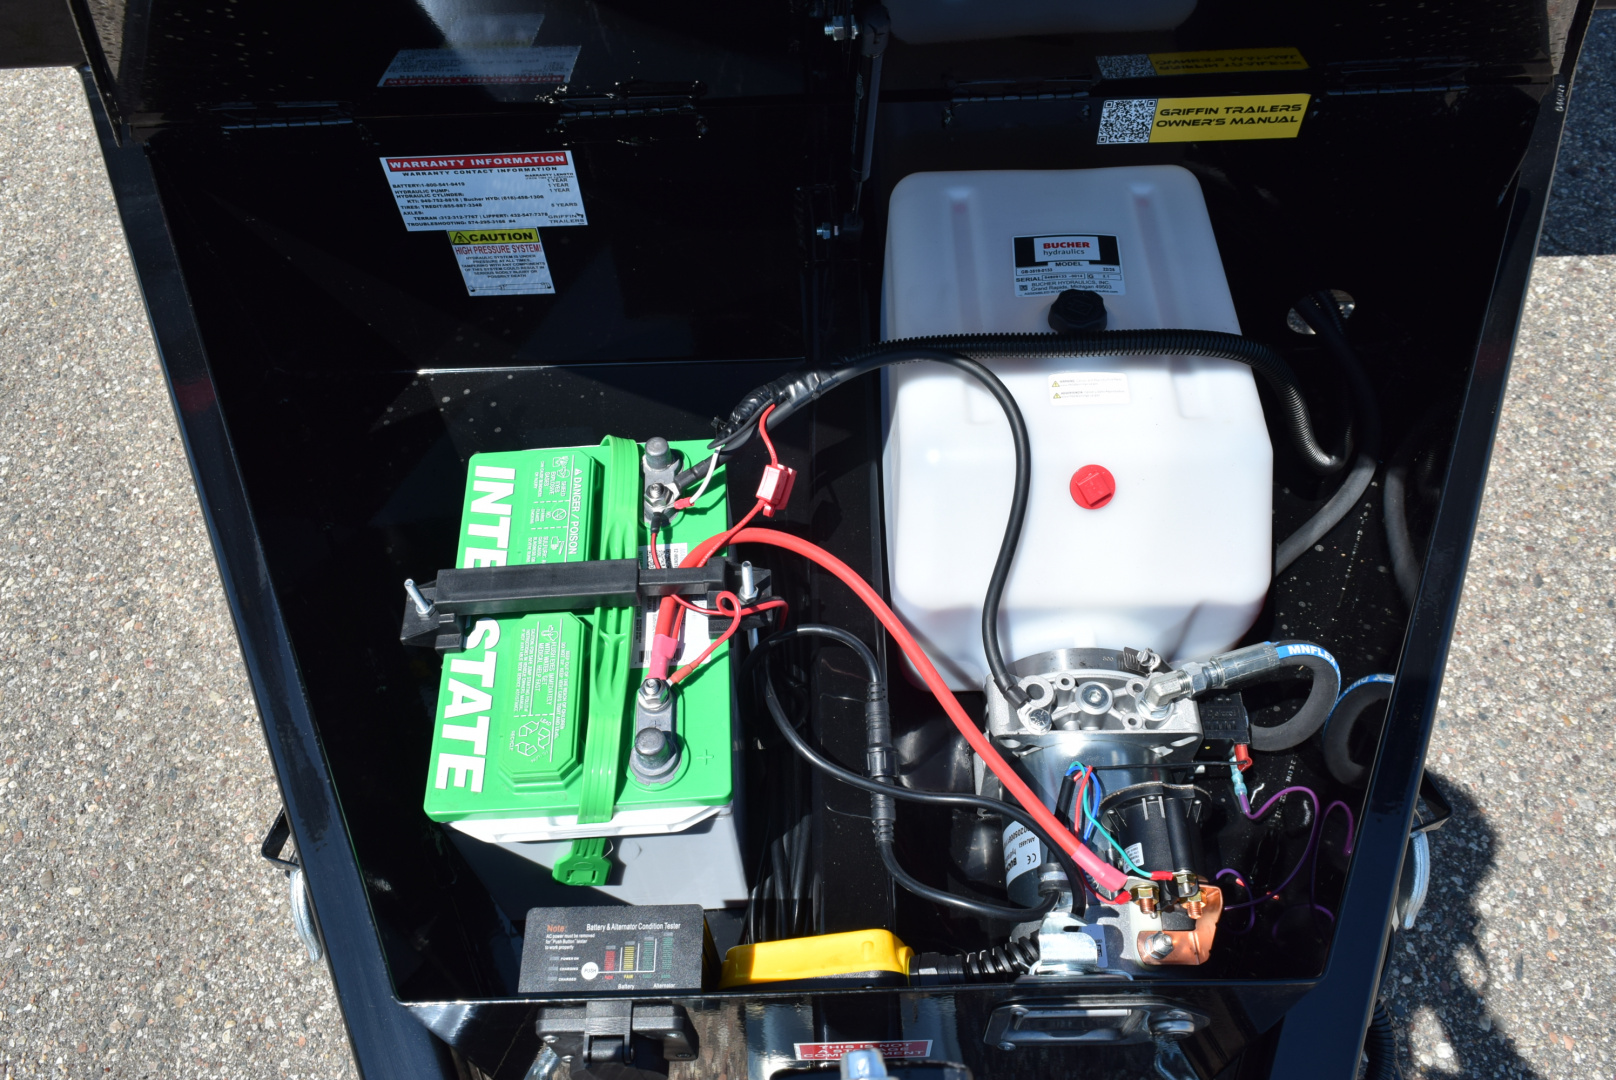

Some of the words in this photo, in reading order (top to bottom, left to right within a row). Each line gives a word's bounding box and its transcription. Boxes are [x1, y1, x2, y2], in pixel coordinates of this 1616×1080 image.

[1159, 106, 1219, 116] GRIFFIN
[1223, 104, 1303, 114] TRAILERS
[1156, 118, 1226, 127] OWNER'S
[1229, 115, 1299, 125] MANUAL
[389, 159, 465, 169] WARRANTY
[470, 155, 565, 166] INFORMATION
[468, 232, 533, 242] CAUTION
[455, 246, 474, 255] HIGH
[473, 244, 511, 254] PRESSURE
[511, 243, 542, 254] SYSTEM!
[1043, 241, 1091, 249] BUCHER
[1043, 249, 1085, 257] hydraulics
[571, 477, 584, 512] DANGER
[568, 521, 581, 555] POISON
[537, 642, 545, 664] MEDICAL
[1287, 644, 1337, 665] MNFLEX
[546, 672, 556, 706] IMMEDIATELY
[586, 922, 606, 932] Battery
[606, 922, 611, 931] &
[611, 922, 637, 931] Alternator
[637, 922, 664, 931] Condition
[664, 922, 681, 930] Tester
